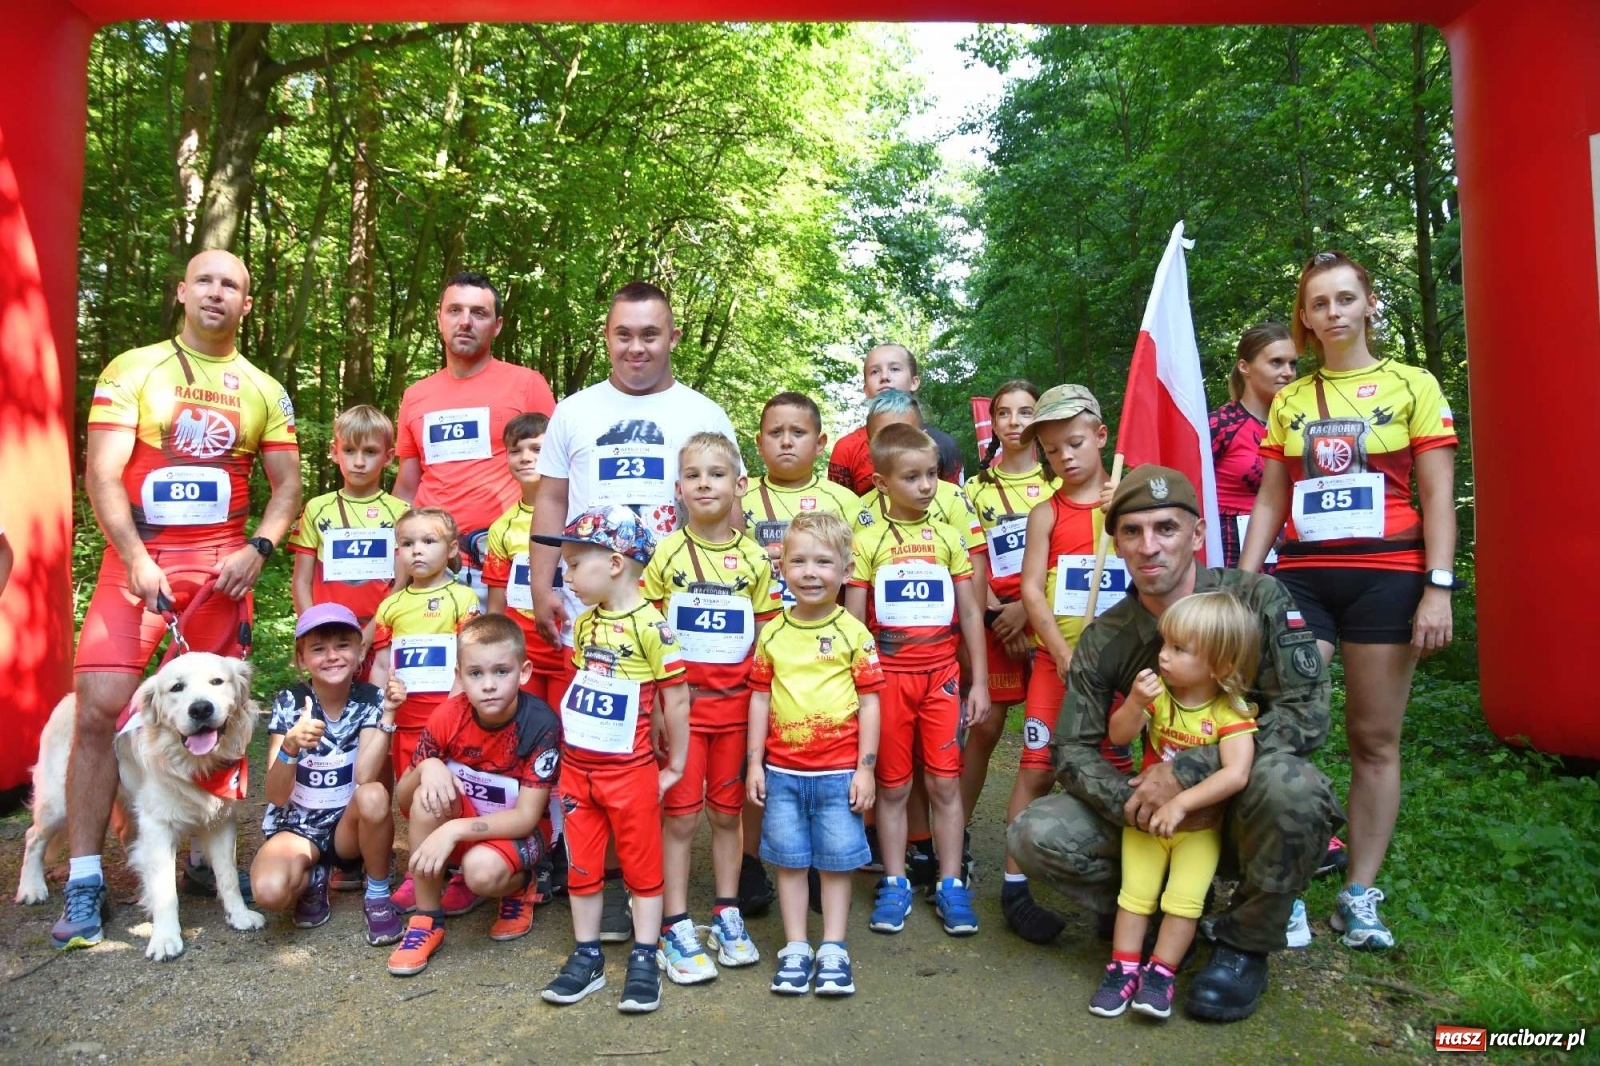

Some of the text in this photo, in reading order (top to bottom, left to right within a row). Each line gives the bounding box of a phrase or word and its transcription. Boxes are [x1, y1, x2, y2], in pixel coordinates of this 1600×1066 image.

[174, 385, 241, 408] RACIBORKI
[441, 423, 465, 440] 76
[1309, 424, 1363, 435] RACIBORKI
[616, 458, 646, 477] 23
[170, 483, 200, 500] 80
[1321, 489, 1352, 510] 85
[346, 540, 373, 556] 47
[1006, 530, 1026, 548] 97
[891, 544, 936, 555] RACIBORKI
[901, 581, 930, 600] 40
[695, 610, 727, 630] 45
[403, 648, 429, 666] 77
[575, 688, 614, 716] 113
[1027, 726, 1040, 742] B
[309, 770, 339, 787] 96
[464, 781, 489, 800] 82
